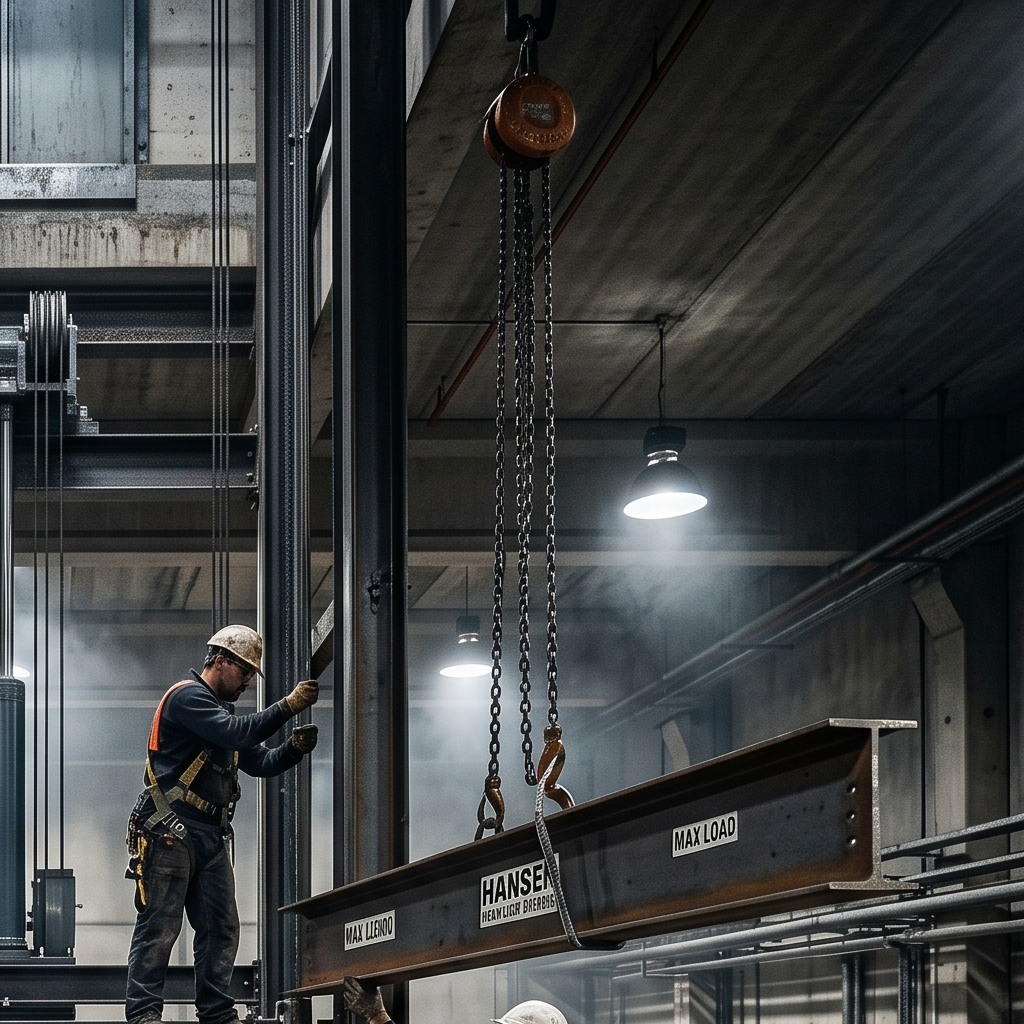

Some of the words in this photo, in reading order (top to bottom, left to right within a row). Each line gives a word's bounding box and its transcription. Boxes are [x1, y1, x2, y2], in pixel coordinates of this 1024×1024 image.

[675, 826, 700, 851] MAX
[704, 817, 735, 843] LOAD
[346, 924, 363, 945] MAX
